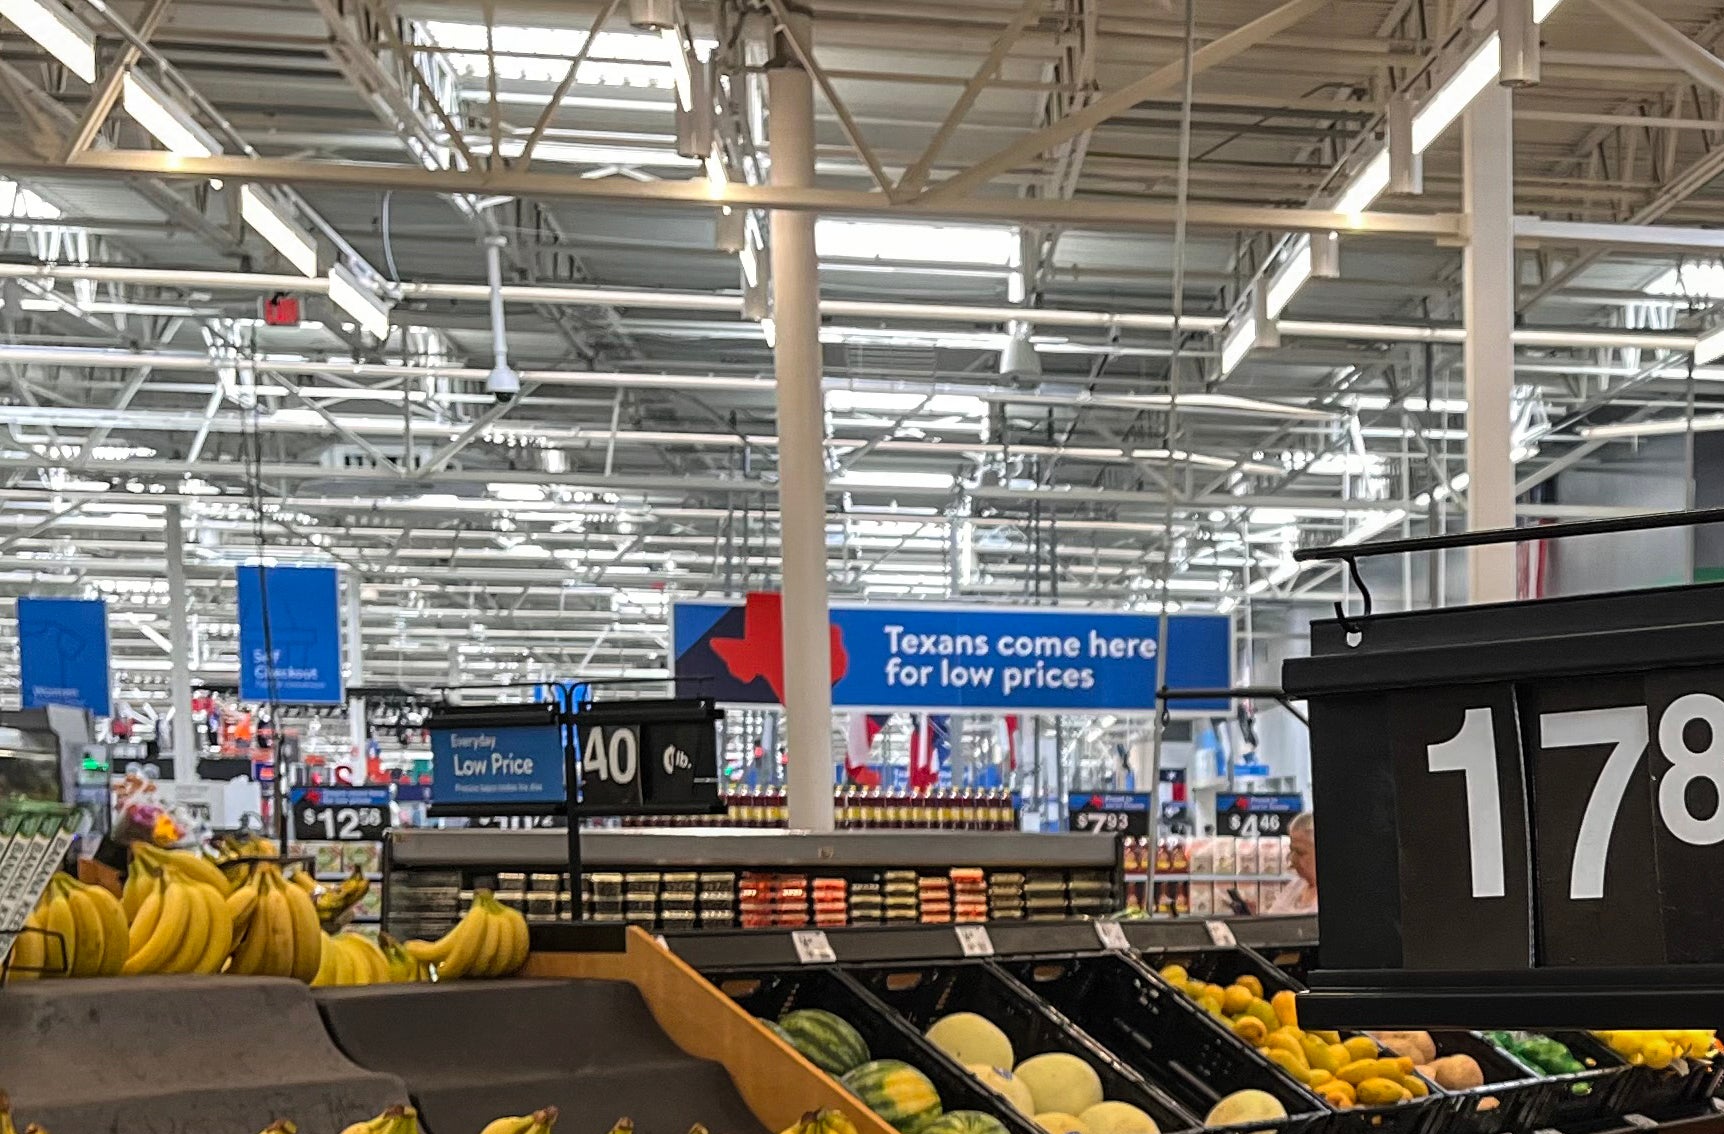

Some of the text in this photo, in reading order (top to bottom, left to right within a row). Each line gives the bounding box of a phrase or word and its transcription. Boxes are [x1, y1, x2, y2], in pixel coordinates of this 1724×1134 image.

[253, 648, 281, 663] Sef
[884, 625, 1158, 661] Texans come here
[885, 656, 1095, 696] for low prices
[451, 733, 496, 751] Everyday
[453, 751, 534, 777] Low Price
